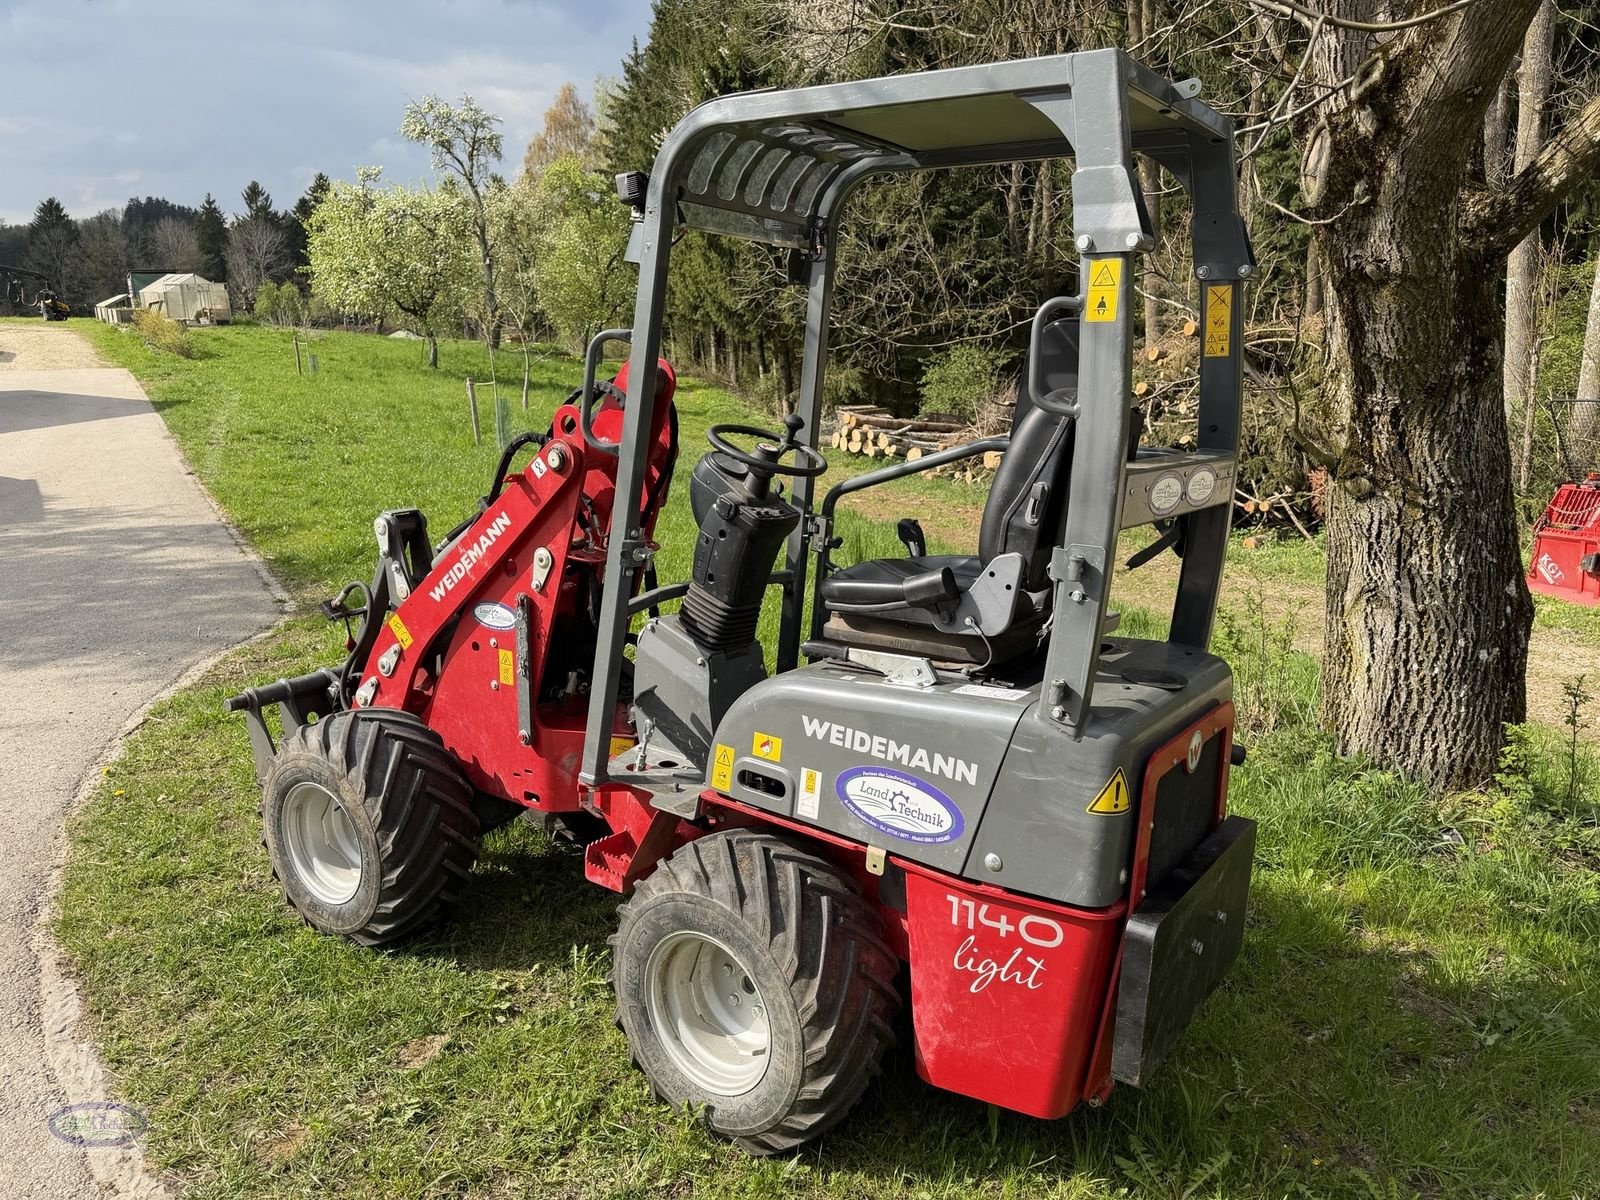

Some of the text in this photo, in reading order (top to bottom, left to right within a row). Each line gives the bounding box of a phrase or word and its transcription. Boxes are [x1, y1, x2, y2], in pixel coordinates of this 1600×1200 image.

[429, 511, 513, 603] WEIDEMANN
[801, 714, 979, 786] WEIDEMANN
[860, 780, 890, 801] Land
[898, 802, 944, 828] Technik
[946, 894, 1064, 948] 1140
[953, 934, 1047, 993] light
